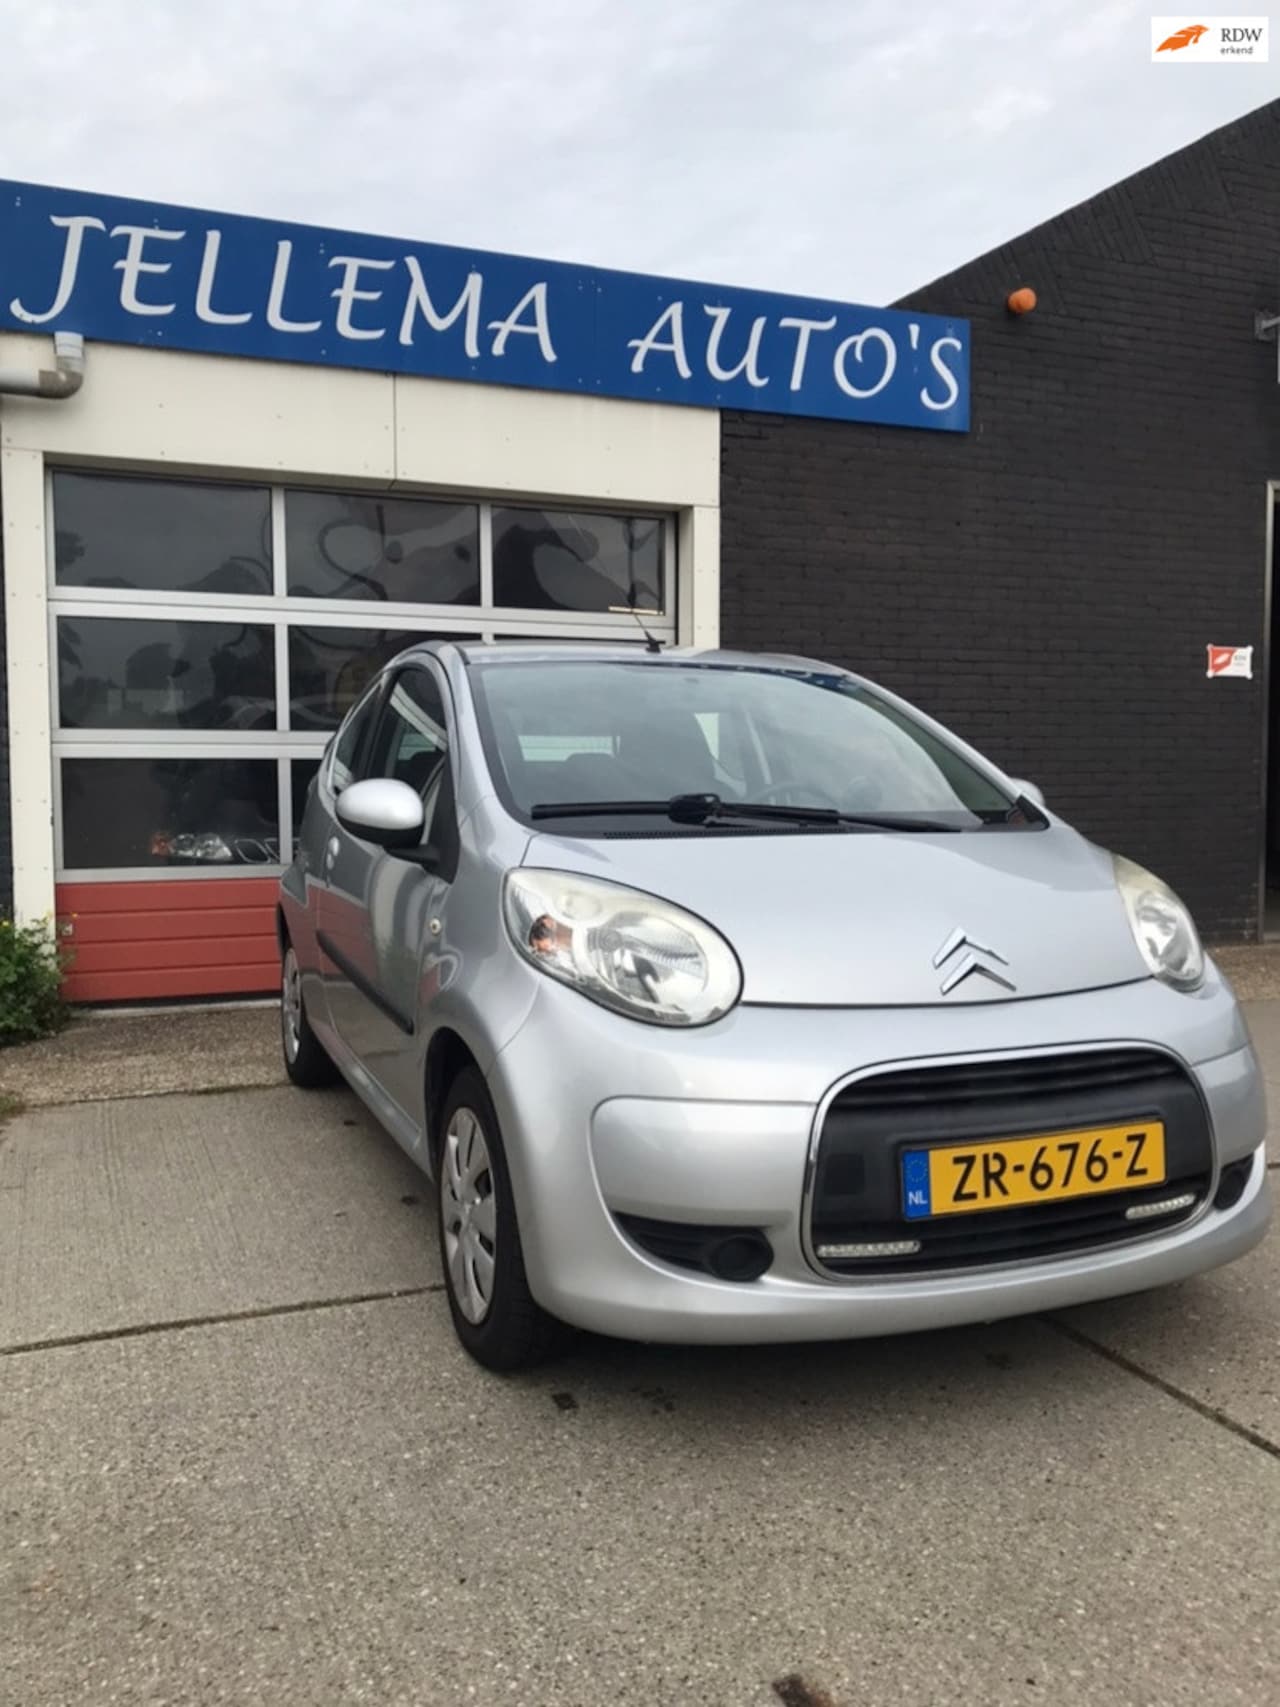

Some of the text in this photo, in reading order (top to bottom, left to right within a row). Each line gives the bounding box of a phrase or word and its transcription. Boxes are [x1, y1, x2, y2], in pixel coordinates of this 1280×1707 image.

[10, 214, 964, 411] JELLEMA AUTO'S
[908, 1132, 1149, 1206] NL ZR-676-Z
